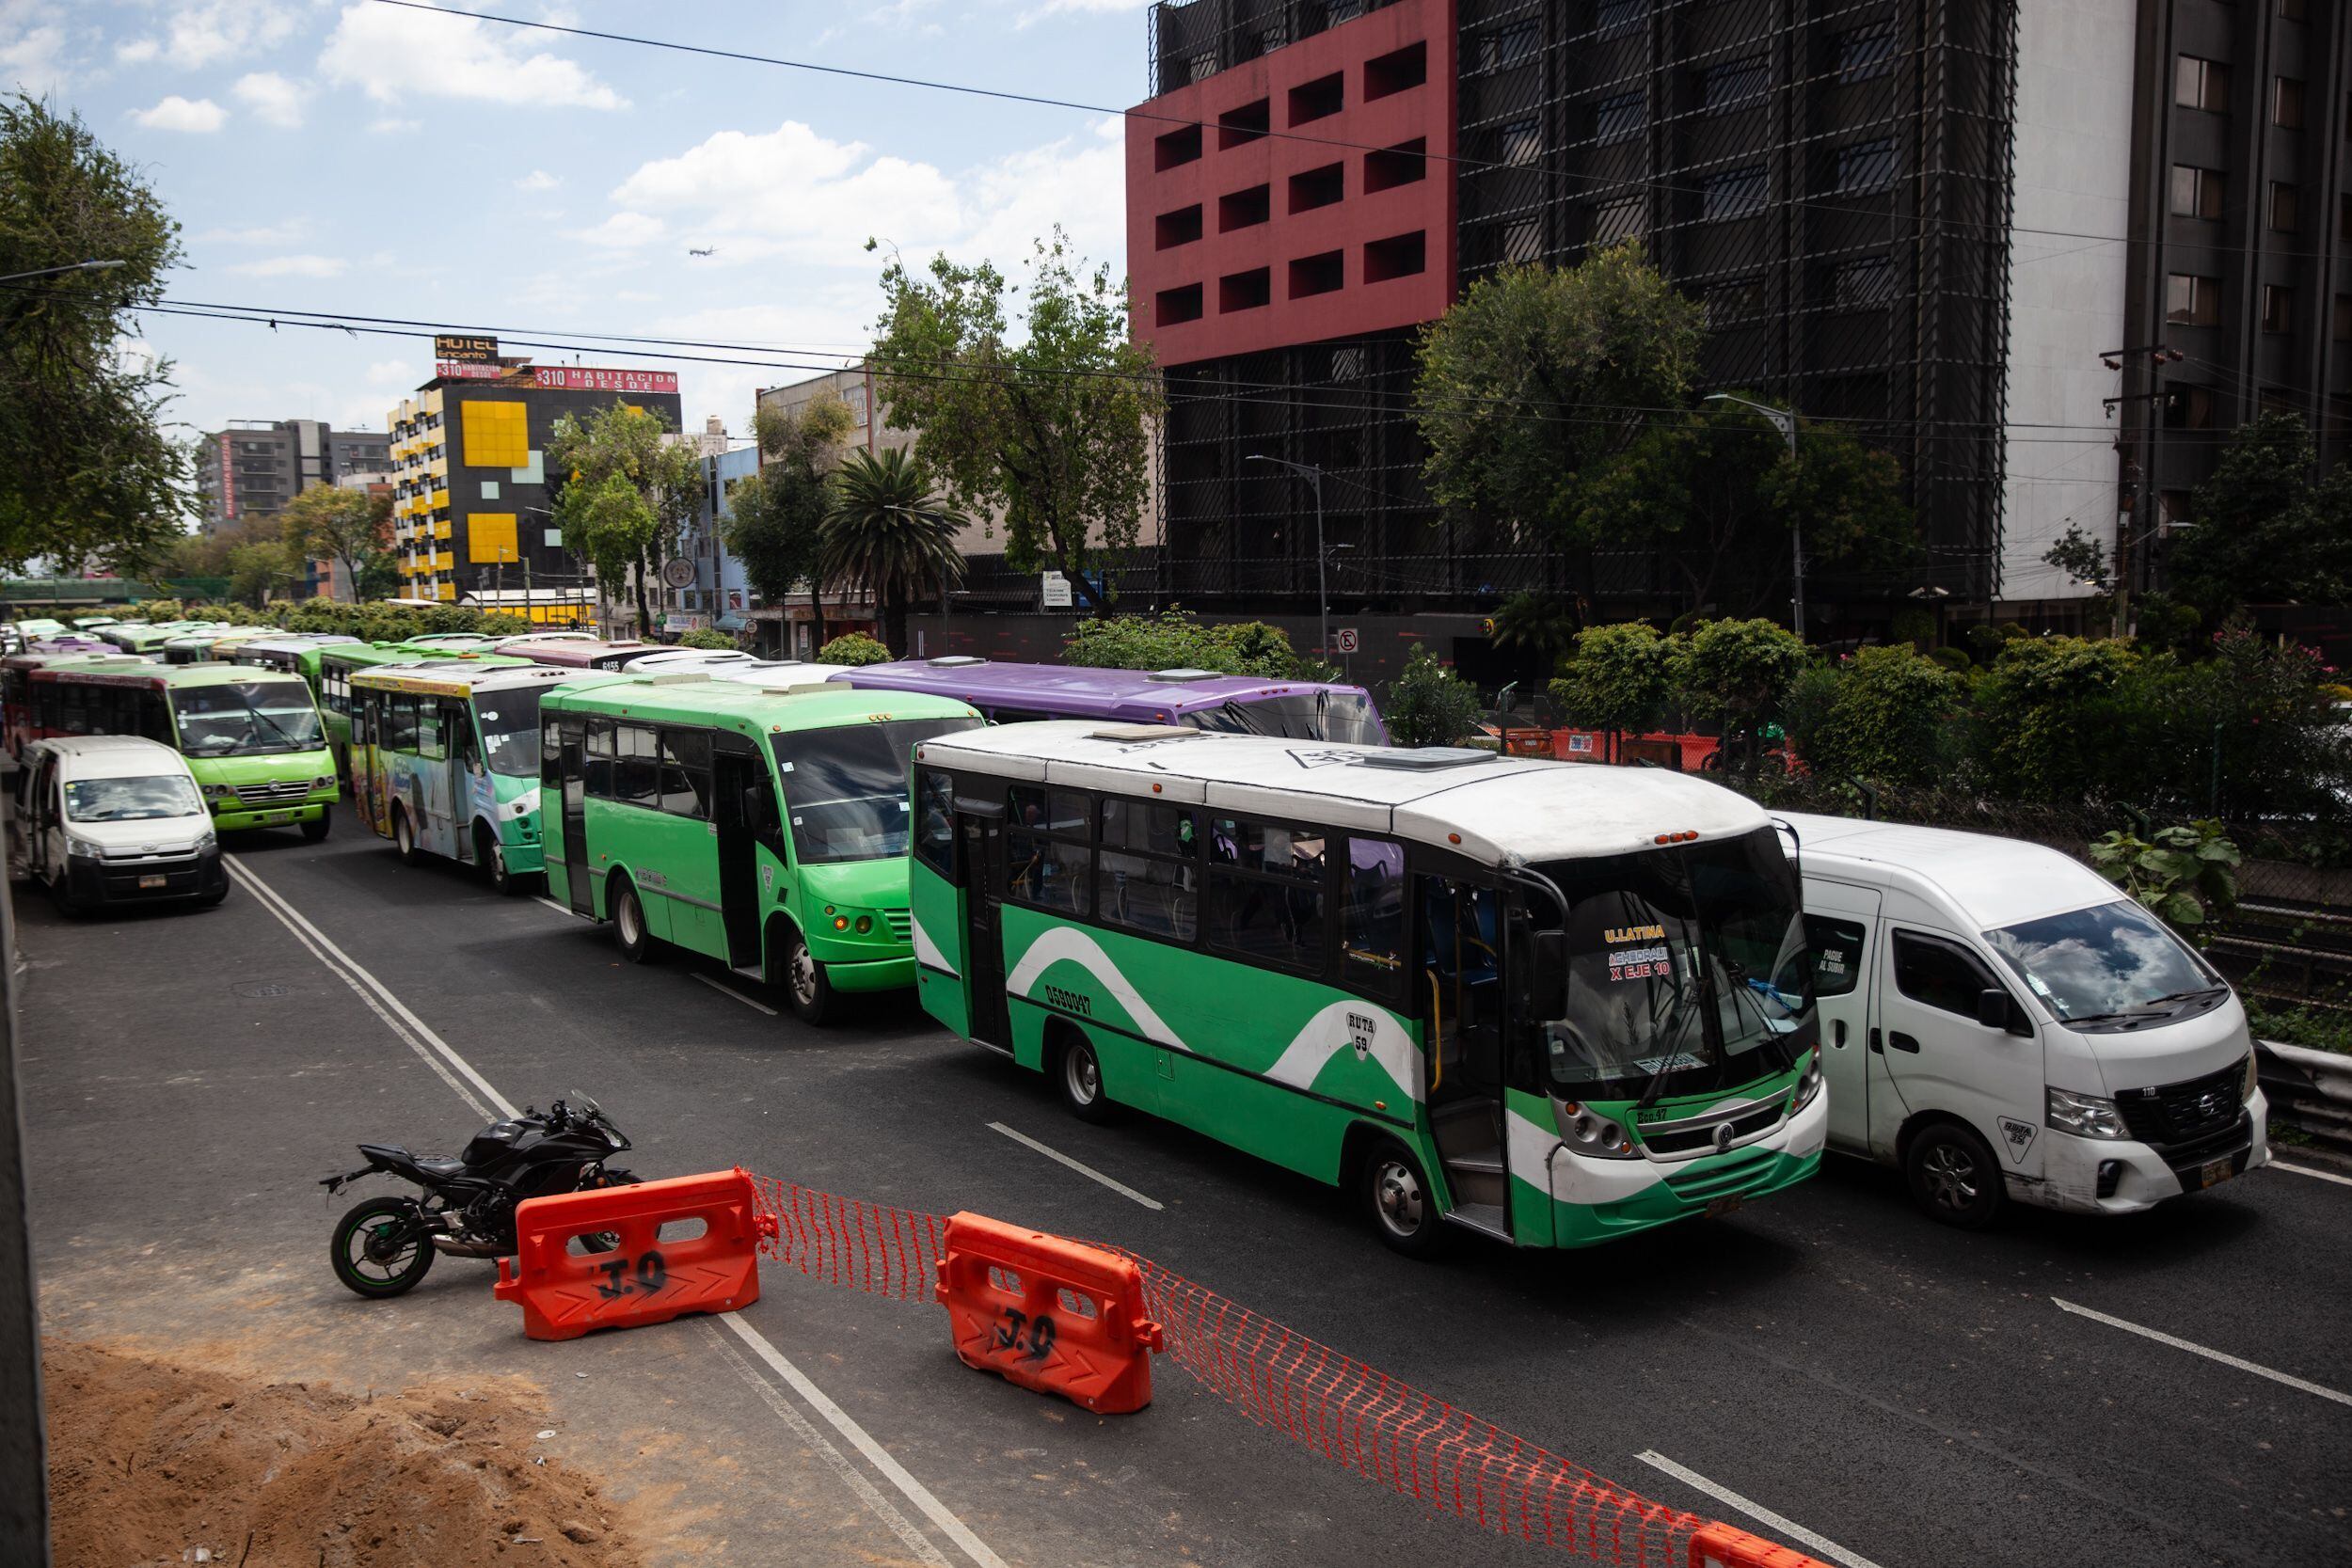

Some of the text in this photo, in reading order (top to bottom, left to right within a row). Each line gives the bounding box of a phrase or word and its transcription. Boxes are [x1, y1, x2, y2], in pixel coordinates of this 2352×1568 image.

[437, 337, 498, 351] HOTEL
[437, 350, 487, 358] Encanto
[537, 370, 676, 387] $310 HABITACION
[585, 380, 653, 389] DESDE
[603, 660, 619, 672] 6155
[1604, 925, 1665, 943] U.LATINA
[1823, 949, 1843, 962] PAGUE
[1610, 961, 1670, 981] X EJE 10
[1819, 959, 1845, 974] AL SUBIR
[1045, 984, 1091, 1016] 0590047
[1349, 1014, 1374, 1033] RUTA
[1356, 1036, 1367, 1052] 59
[2142, 1086, 2155, 1097] 110
[2004, 1121, 2032, 1138] RUTA
